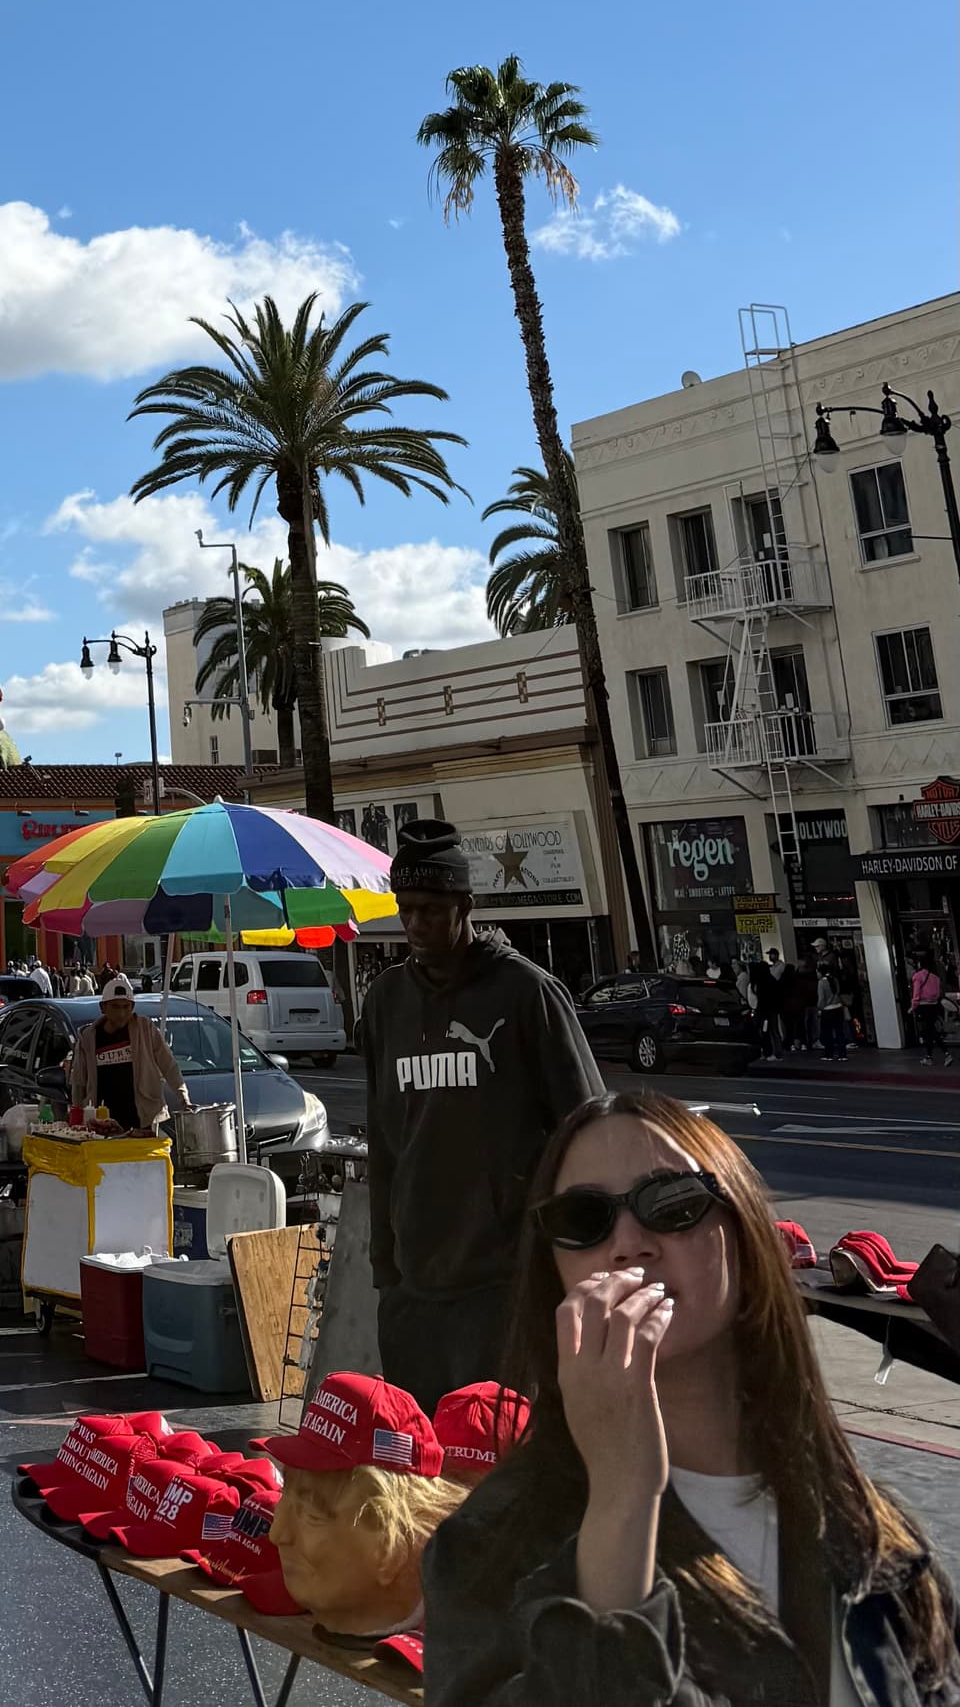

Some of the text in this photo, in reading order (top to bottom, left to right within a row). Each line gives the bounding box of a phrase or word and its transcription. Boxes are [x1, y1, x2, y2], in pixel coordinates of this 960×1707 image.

[795, 819, 847, 841] OLLYWOO
[666, 833, 735, 882] regen
[861, 855, 958, 874] HARLEY-DAVIDSON OF
[396, 1051, 478, 1093] PUMA
[78, 1425, 97, 1444] WAS
[309, 1413, 347, 1445] AGAIN
[163, 1482, 193, 1506] UMP
